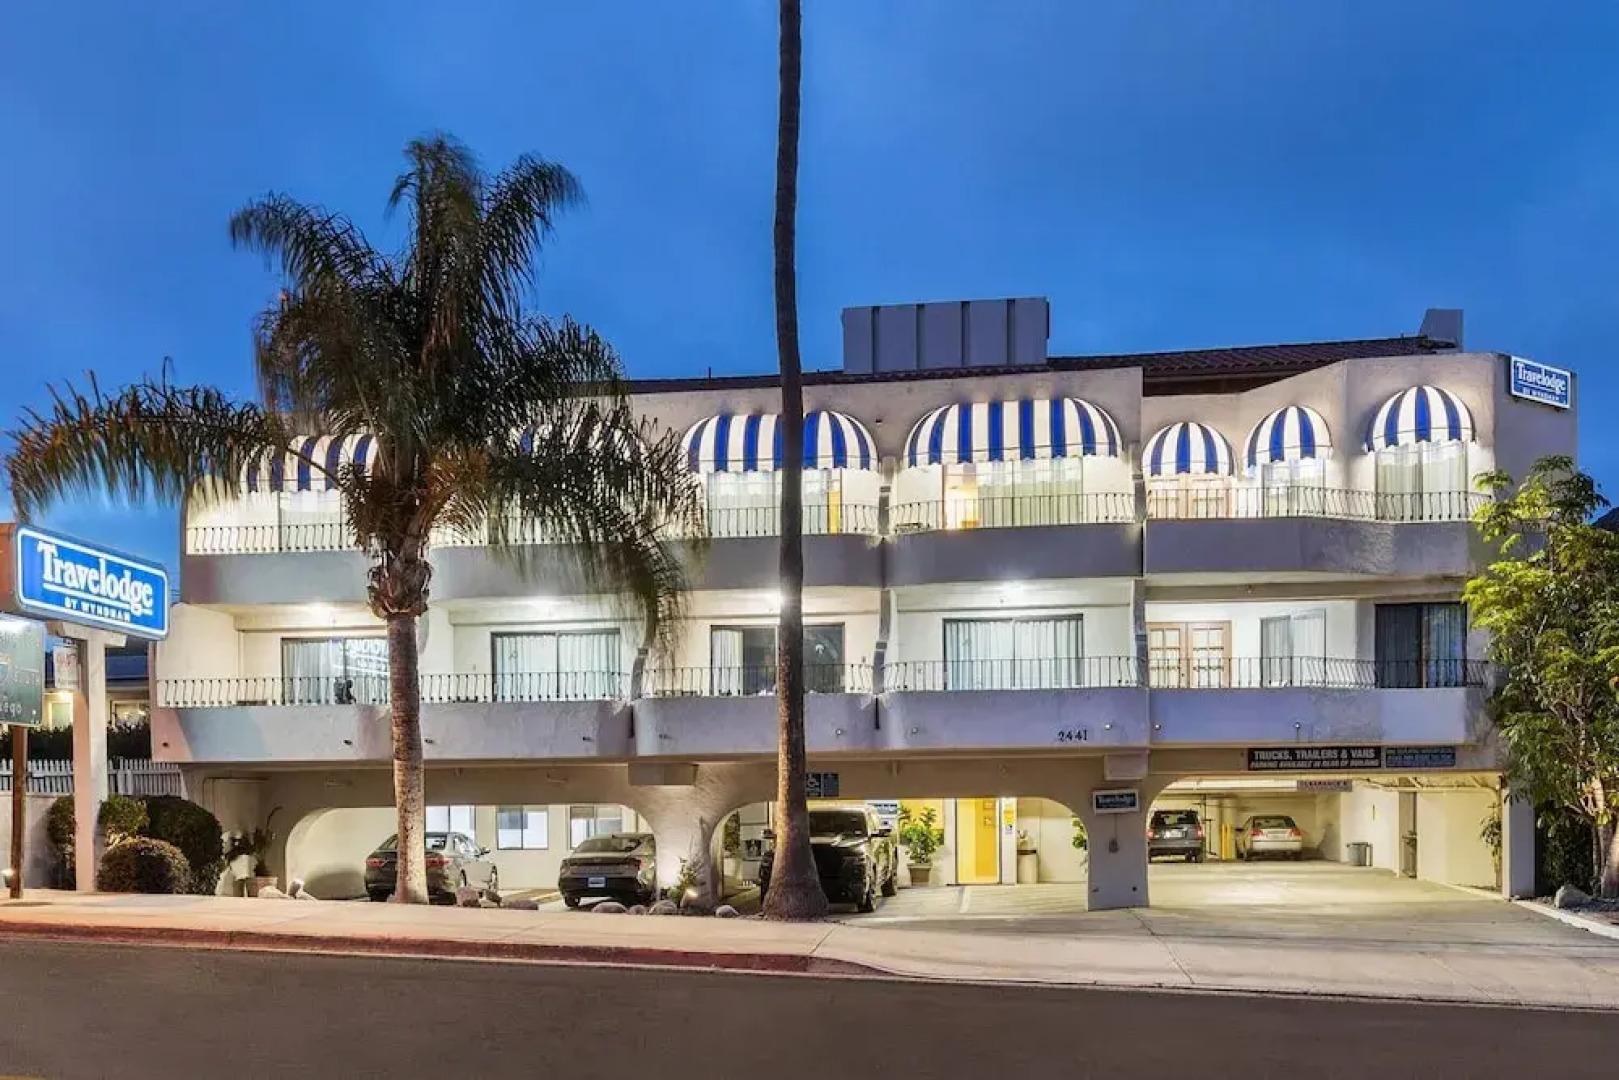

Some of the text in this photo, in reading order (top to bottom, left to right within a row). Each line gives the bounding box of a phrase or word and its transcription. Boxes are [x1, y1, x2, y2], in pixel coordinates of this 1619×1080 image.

[1516, 362, 1566, 395] Travelodge
[37, 541, 154, 618] Travelodge
[1058, 729, 1088, 742] 2441
[1295, 749, 1339, 760] TRAILERS
